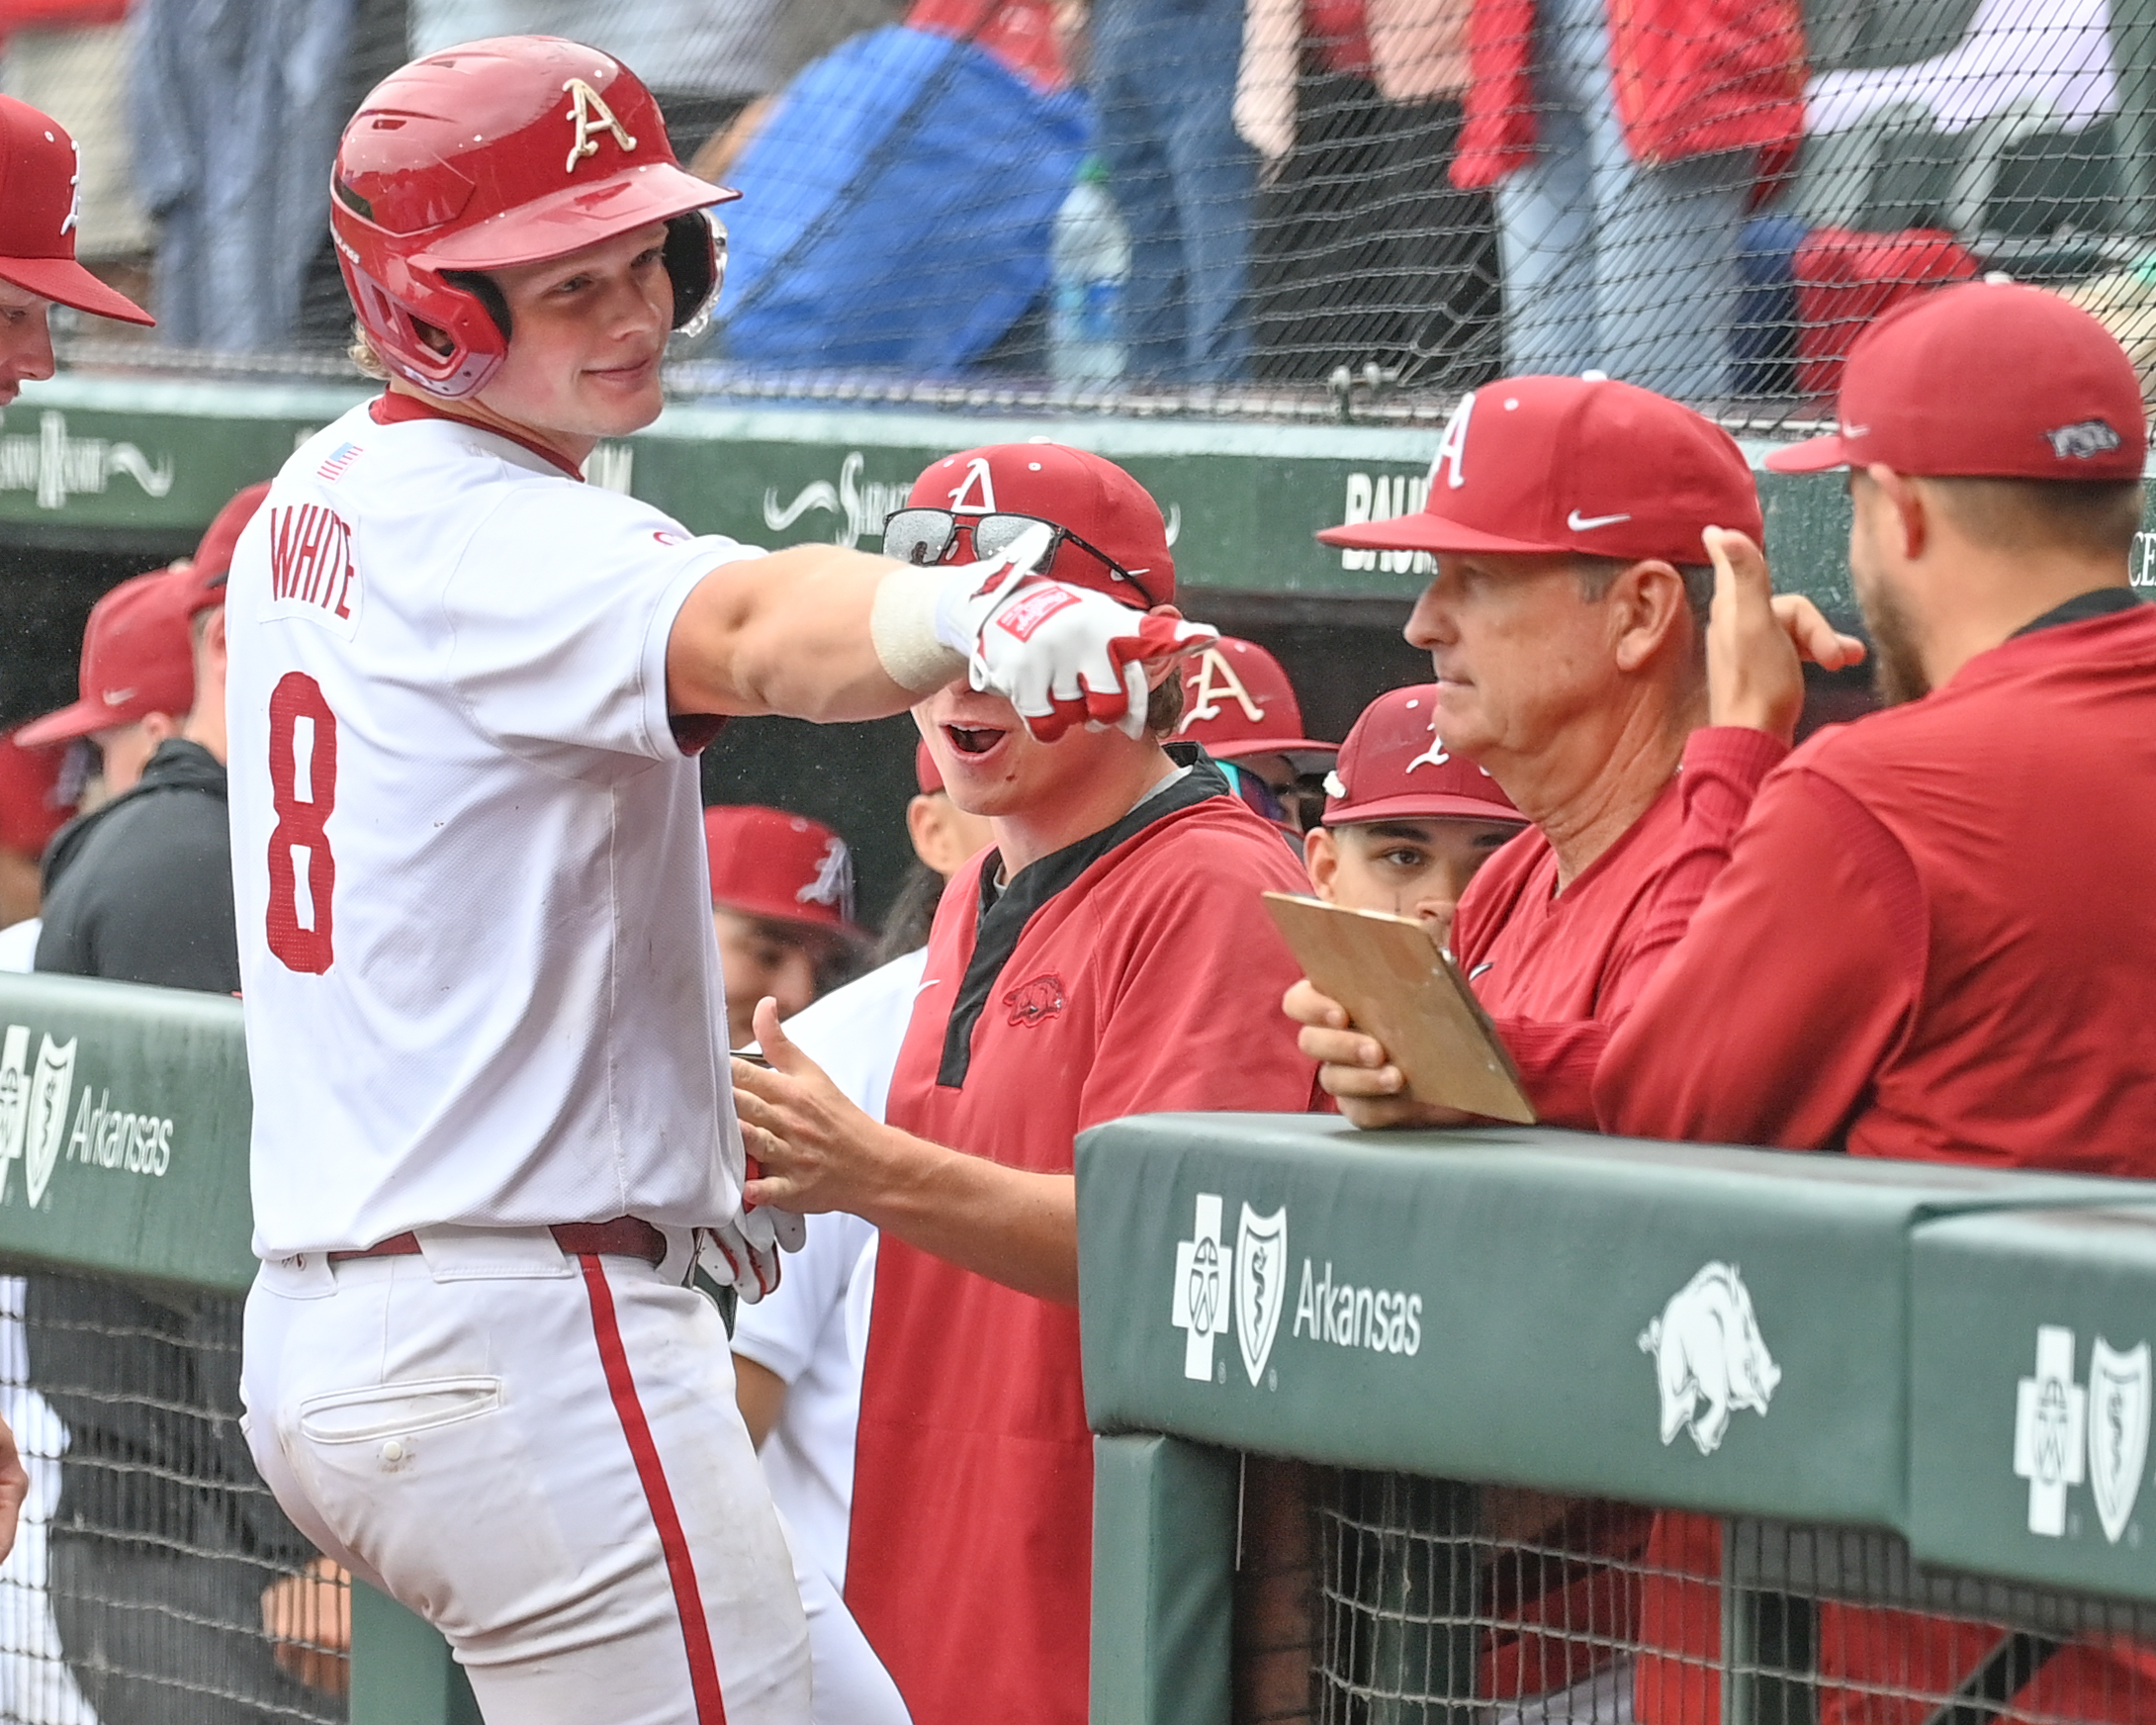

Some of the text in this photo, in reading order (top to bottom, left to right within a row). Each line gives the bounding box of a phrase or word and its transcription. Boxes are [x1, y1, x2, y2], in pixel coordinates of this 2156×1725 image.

[271, 502, 354, 620] WHITE
[266, 670, 336, 975] 8
[66, 1084, 173, 1177] Arkansas
[1293, 1255, 1422, 1356] Arkansas
